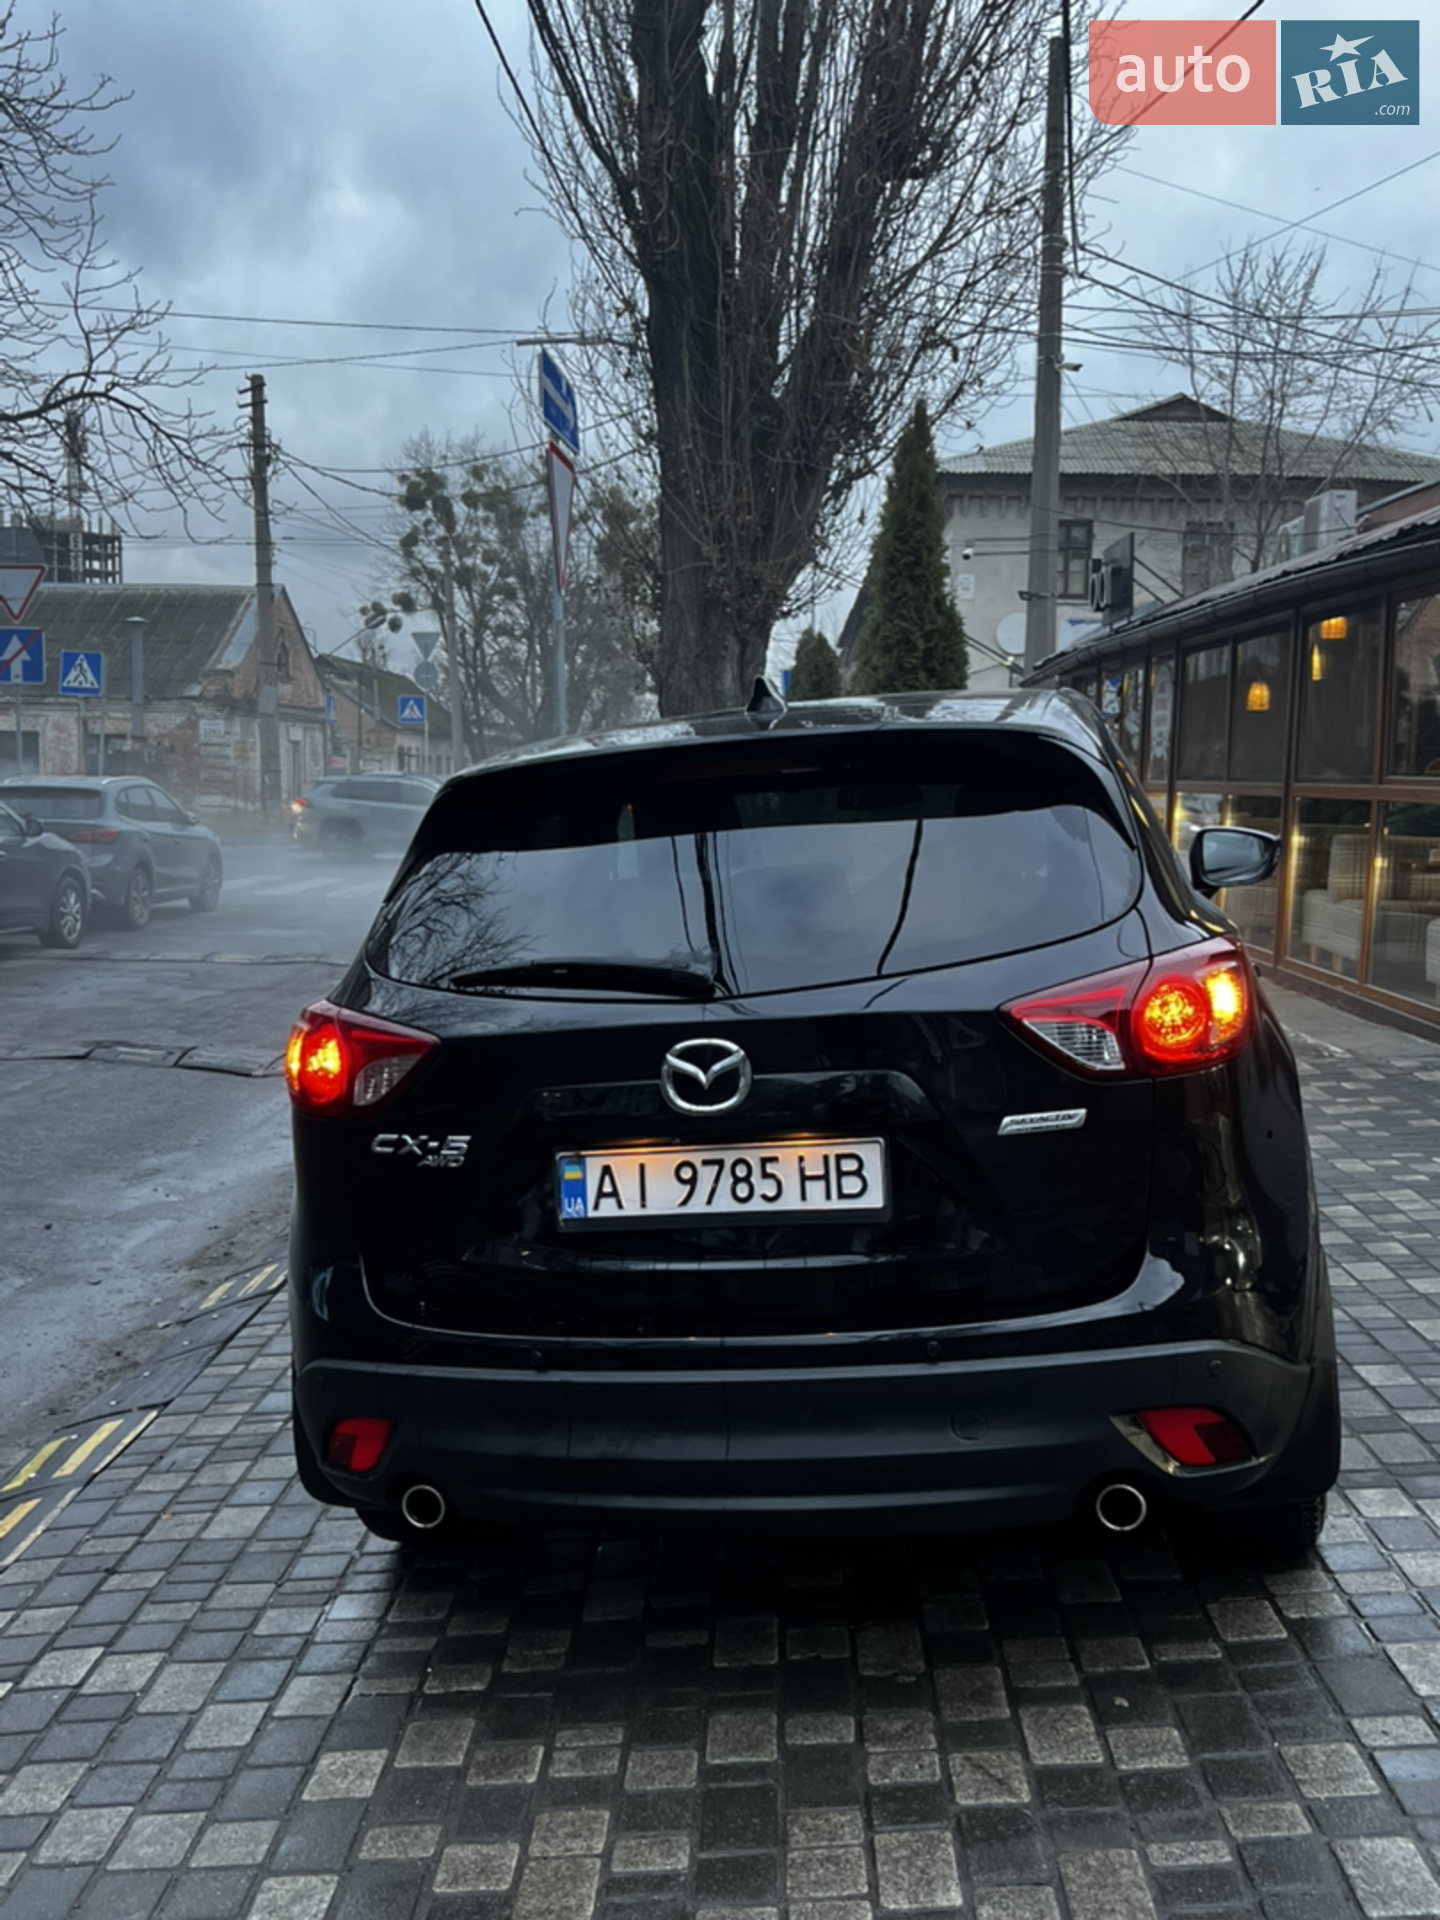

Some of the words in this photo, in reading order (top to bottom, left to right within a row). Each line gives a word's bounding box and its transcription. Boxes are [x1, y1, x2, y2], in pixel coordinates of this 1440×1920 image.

[371, 1133, 472, 1155] CX-5
[417, 1154, 465, 1167] AWD
[592, 1163, 647, 1211] AI
[674, 1156, 783, 1207] 9785
[798, 1152, 869, 1203] HB
[564, 1198, 585, 1214] UA
